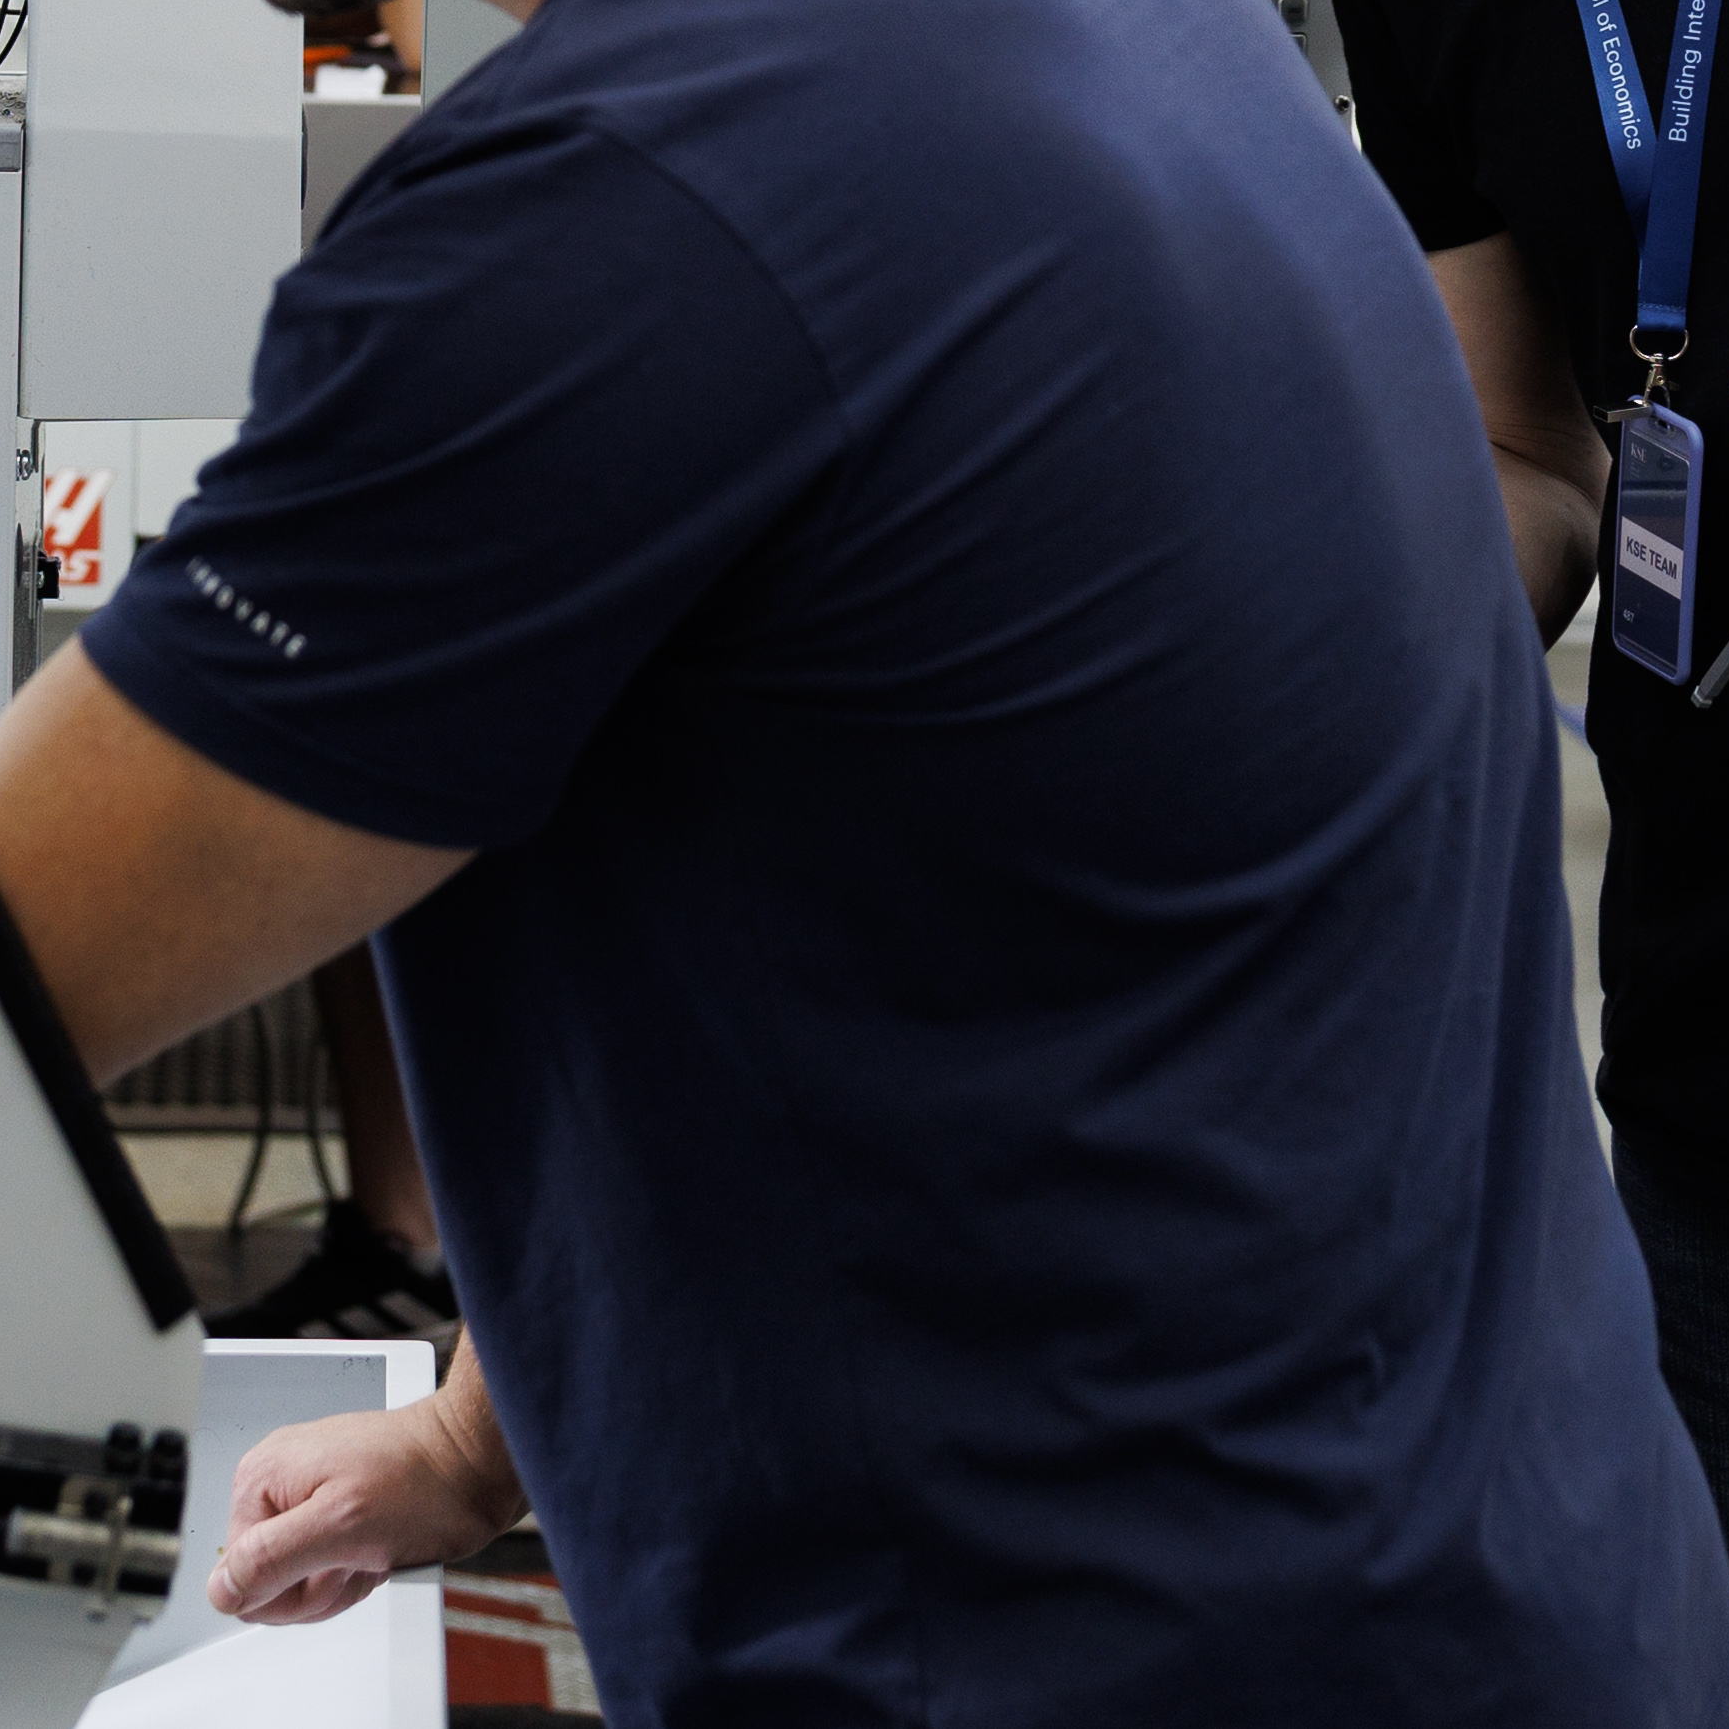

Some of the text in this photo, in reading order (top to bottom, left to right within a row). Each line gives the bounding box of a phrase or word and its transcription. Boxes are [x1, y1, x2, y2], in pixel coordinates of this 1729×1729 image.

[1596, 12, 1617, 33] of
[1602, 36, 1641, 150] Economics
[1668, 48, 1701, 143] Building
[1626, 536, 1678, 580] KSE TEAM
